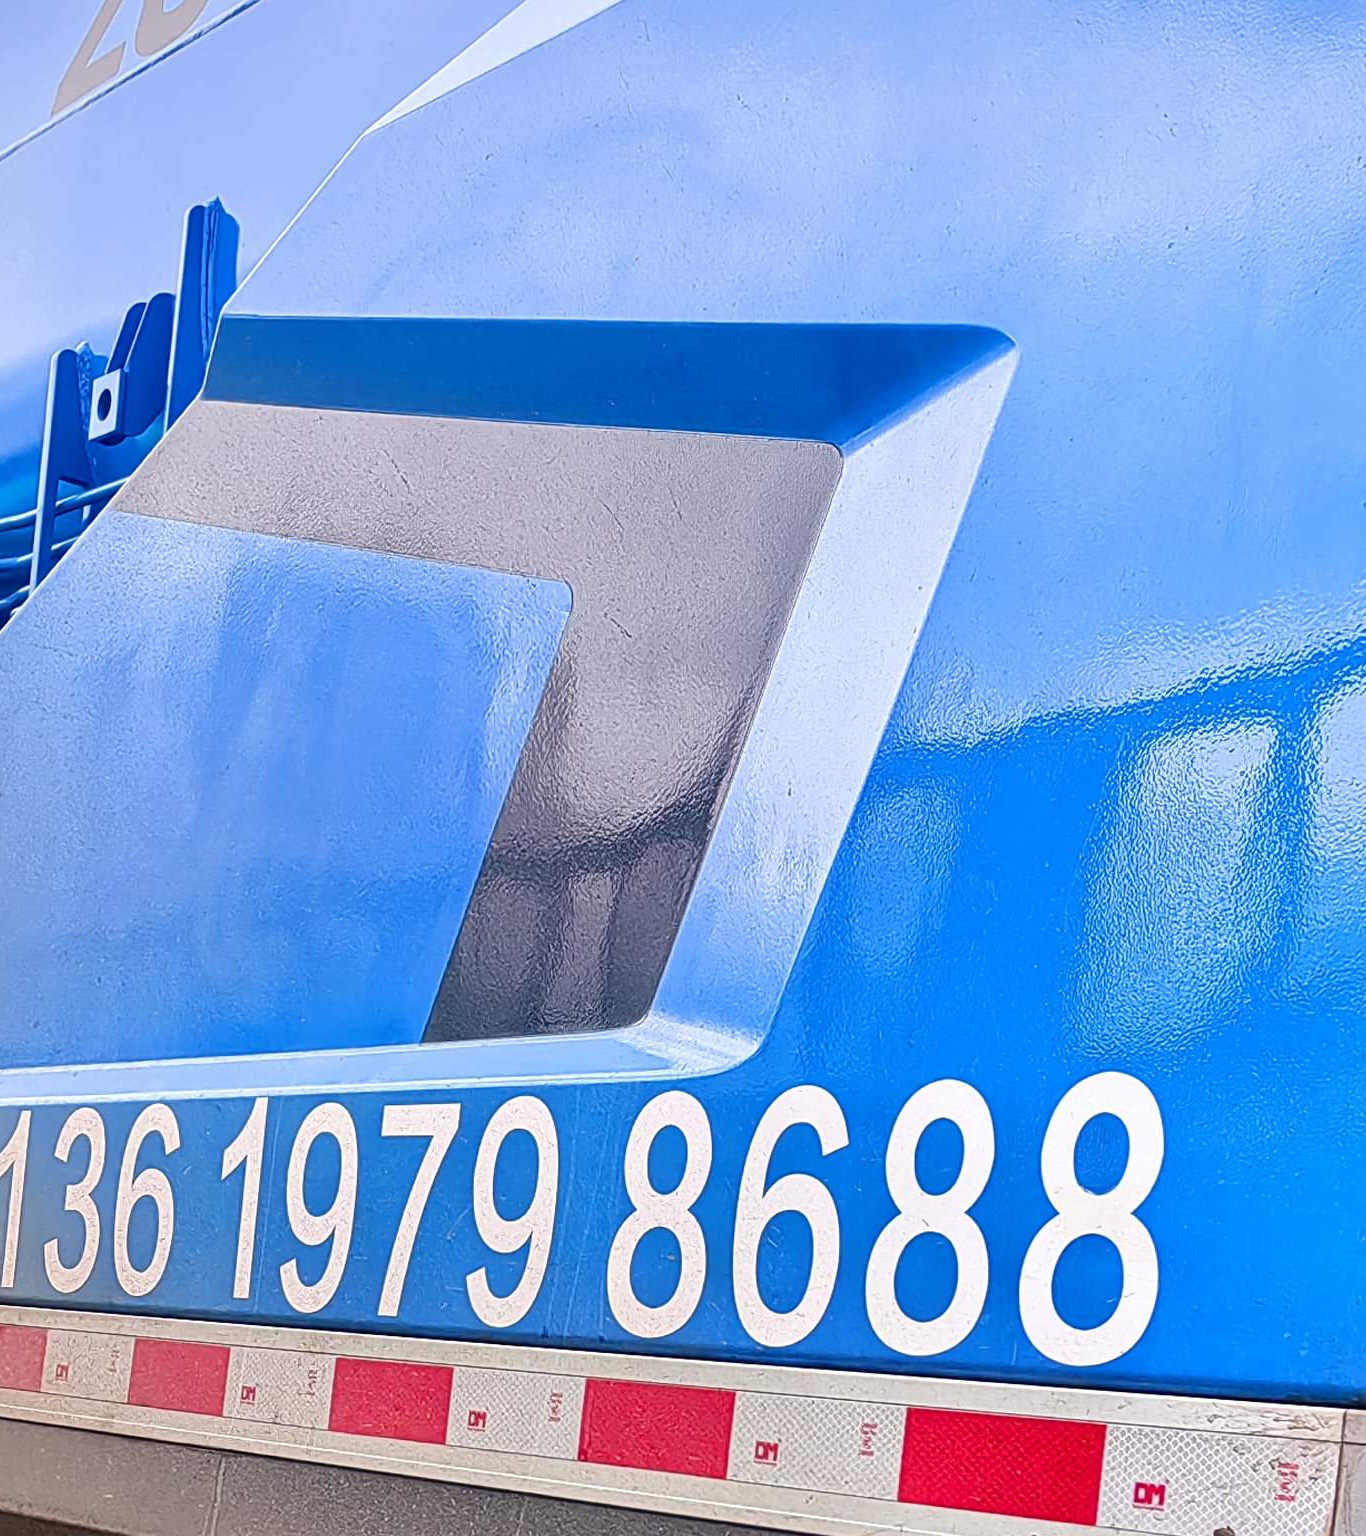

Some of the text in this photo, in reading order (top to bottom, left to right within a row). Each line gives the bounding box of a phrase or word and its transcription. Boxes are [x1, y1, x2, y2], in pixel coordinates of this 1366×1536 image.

[221, 1094, 559, 1329] 1979
[606, 1071, 1165, 1367] 8688
[467, 1409, 487, 1429] DM
[754, 1440, 780, 1462] DM
[1133, 1481, 1167, 1507] DM
